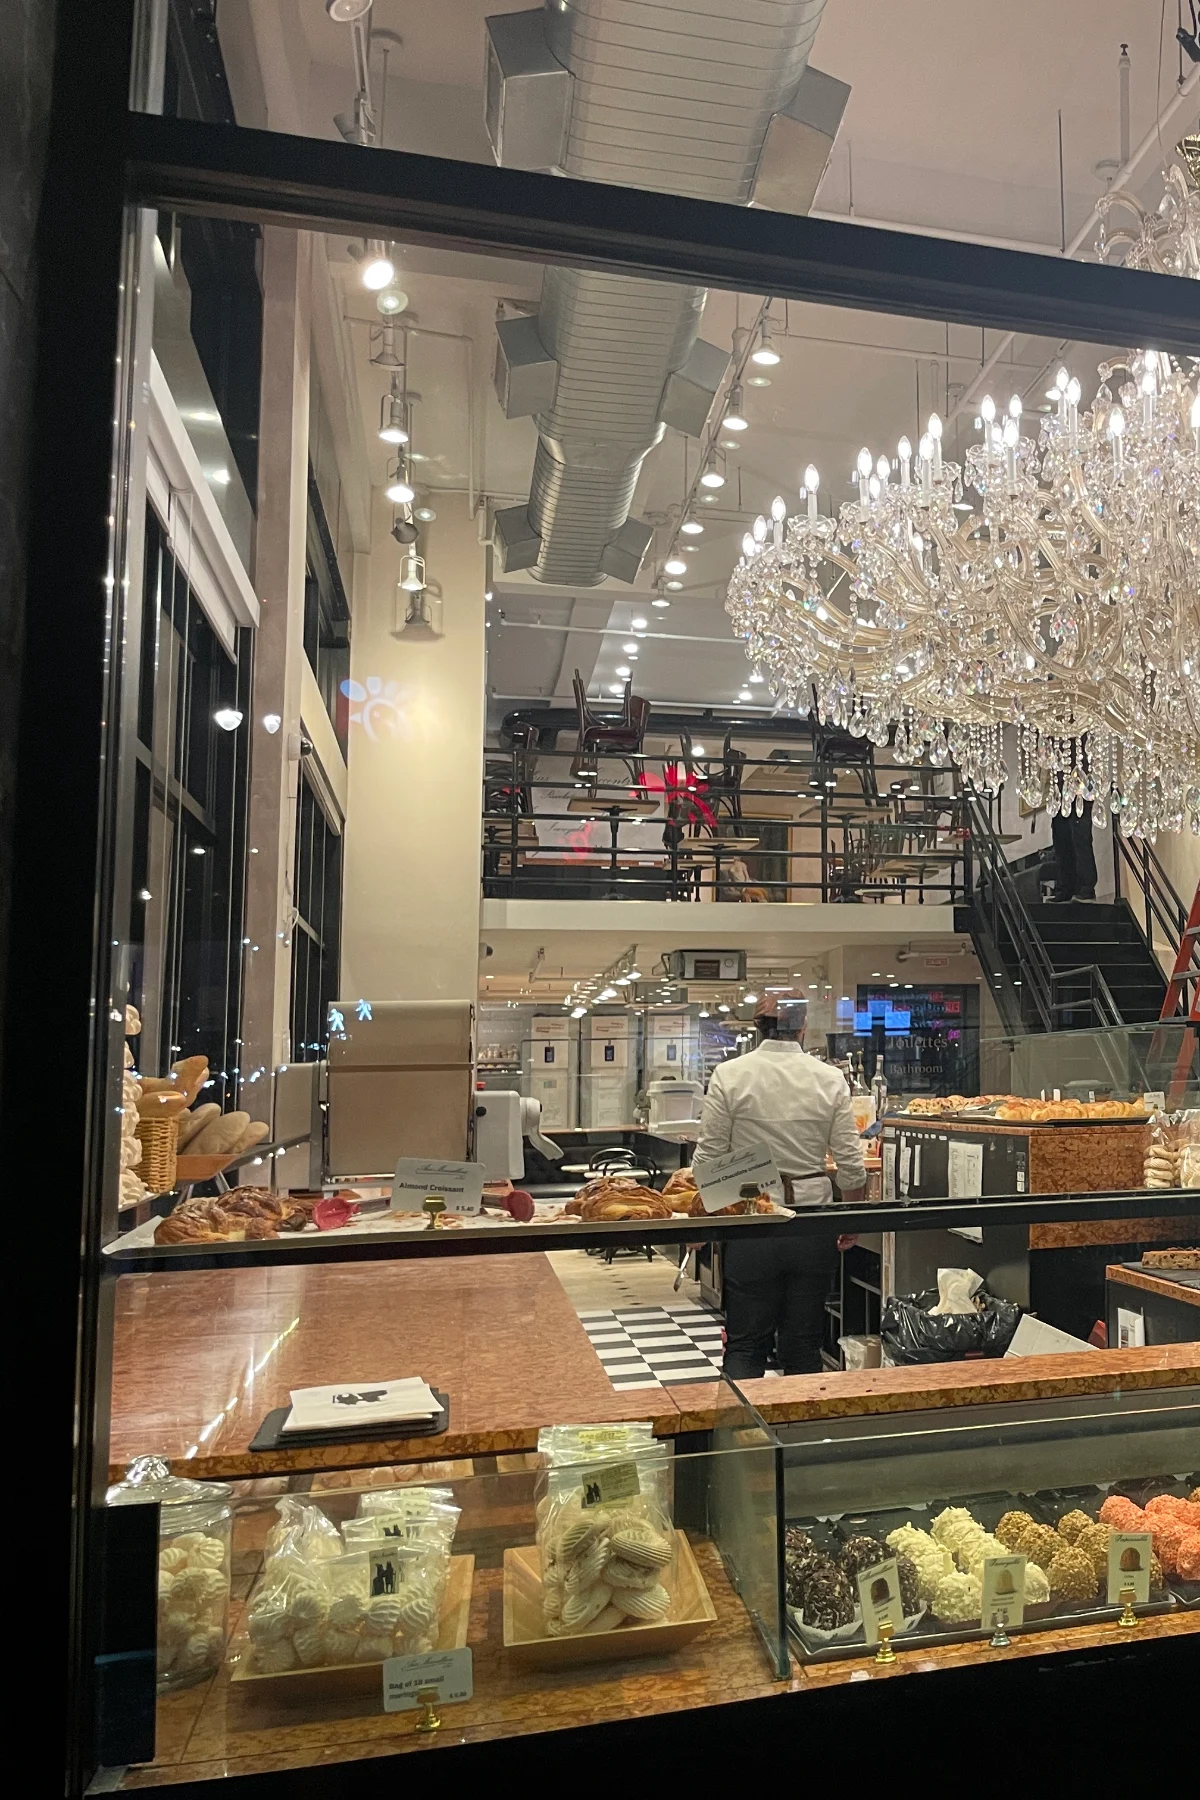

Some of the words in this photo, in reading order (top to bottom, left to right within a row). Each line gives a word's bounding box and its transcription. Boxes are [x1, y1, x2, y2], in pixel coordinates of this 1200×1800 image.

[887, 1034, 949, 1050] Toilettes
[889, 1063, 944, 1075] Bathroom
[399, 1182, 428, 1191] Almond
[429, 1184, 465, 1193] Croissant
